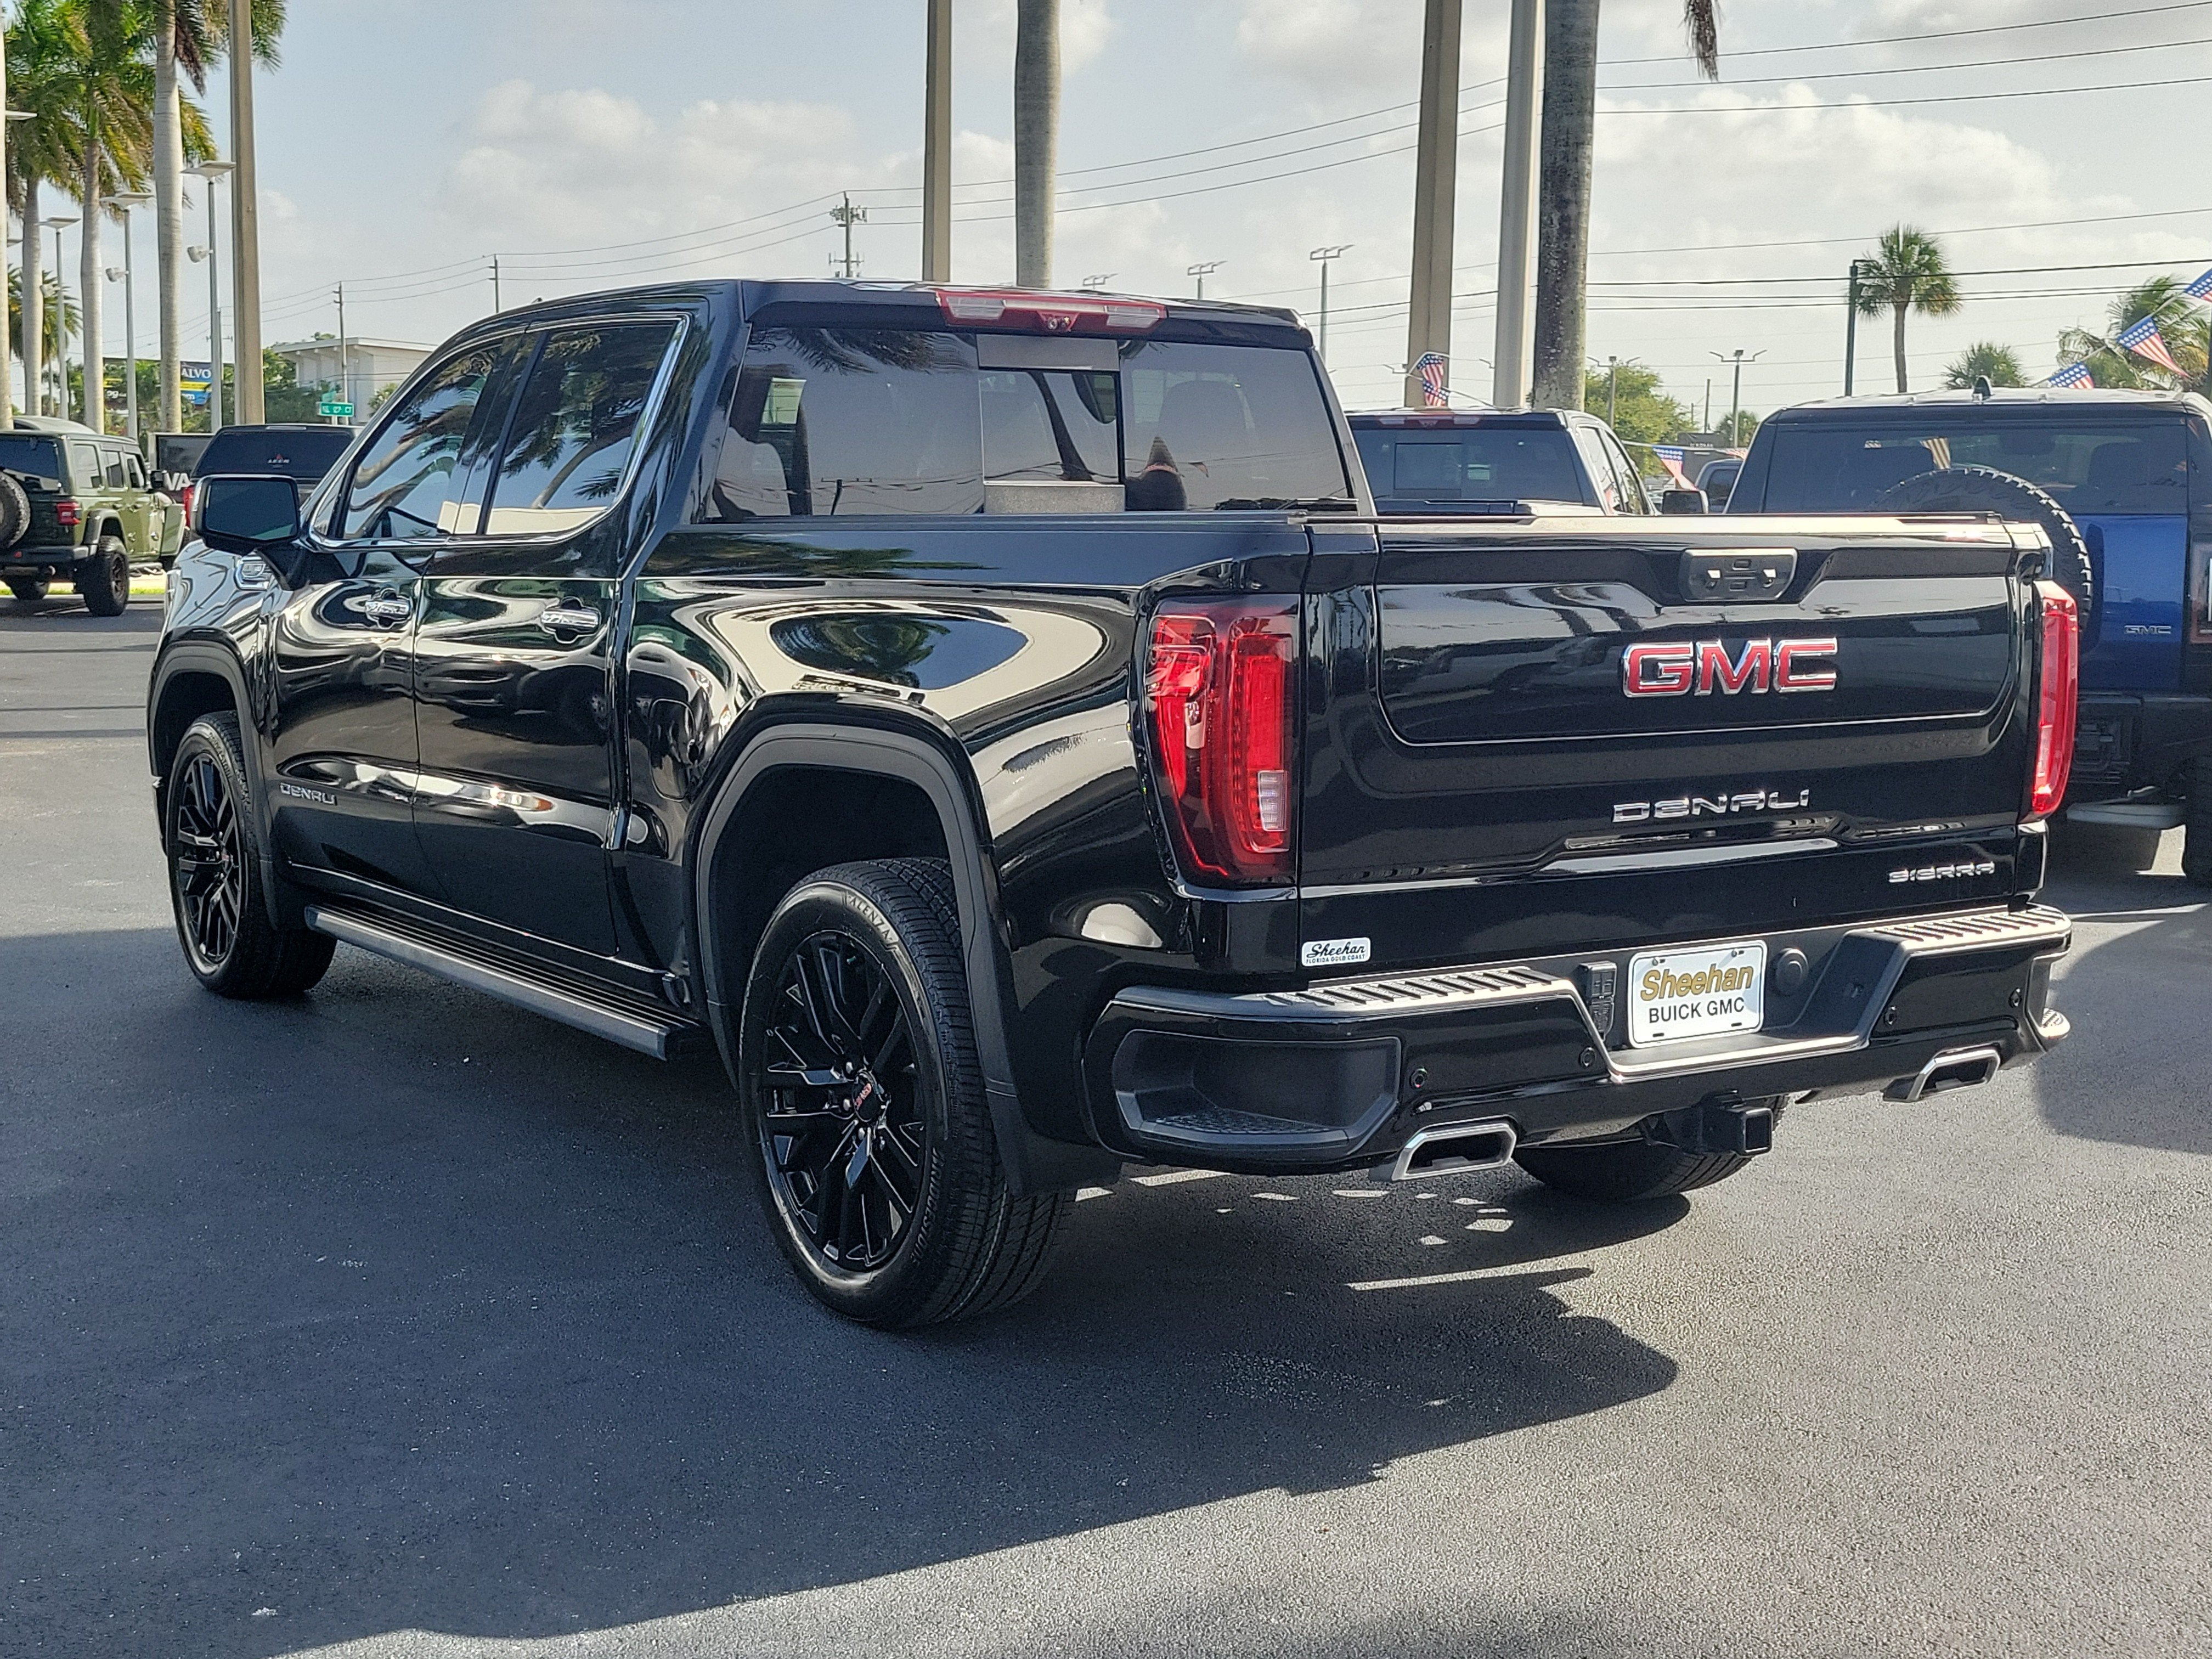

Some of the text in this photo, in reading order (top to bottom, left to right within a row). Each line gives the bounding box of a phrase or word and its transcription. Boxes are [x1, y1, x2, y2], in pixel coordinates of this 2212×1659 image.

[2124, 625, 2171, 634] GMC
[1622, 637, 1838, 698] GMC
[280, 782, 336, 805] DENALI
[1612, 789, 1810, 822] DENALI
[1888, 861, 1995, 883] SIERRA
[849, 896, 890, 940] ALENZA
[1306, 941, 1365, 958] Sheehan
[1306, 956, 1329, 964] FLORIDA
[1640, 963, 1754, 1001] Sheehan
[1649, 997, 1745, 1024] BUICK GMC
